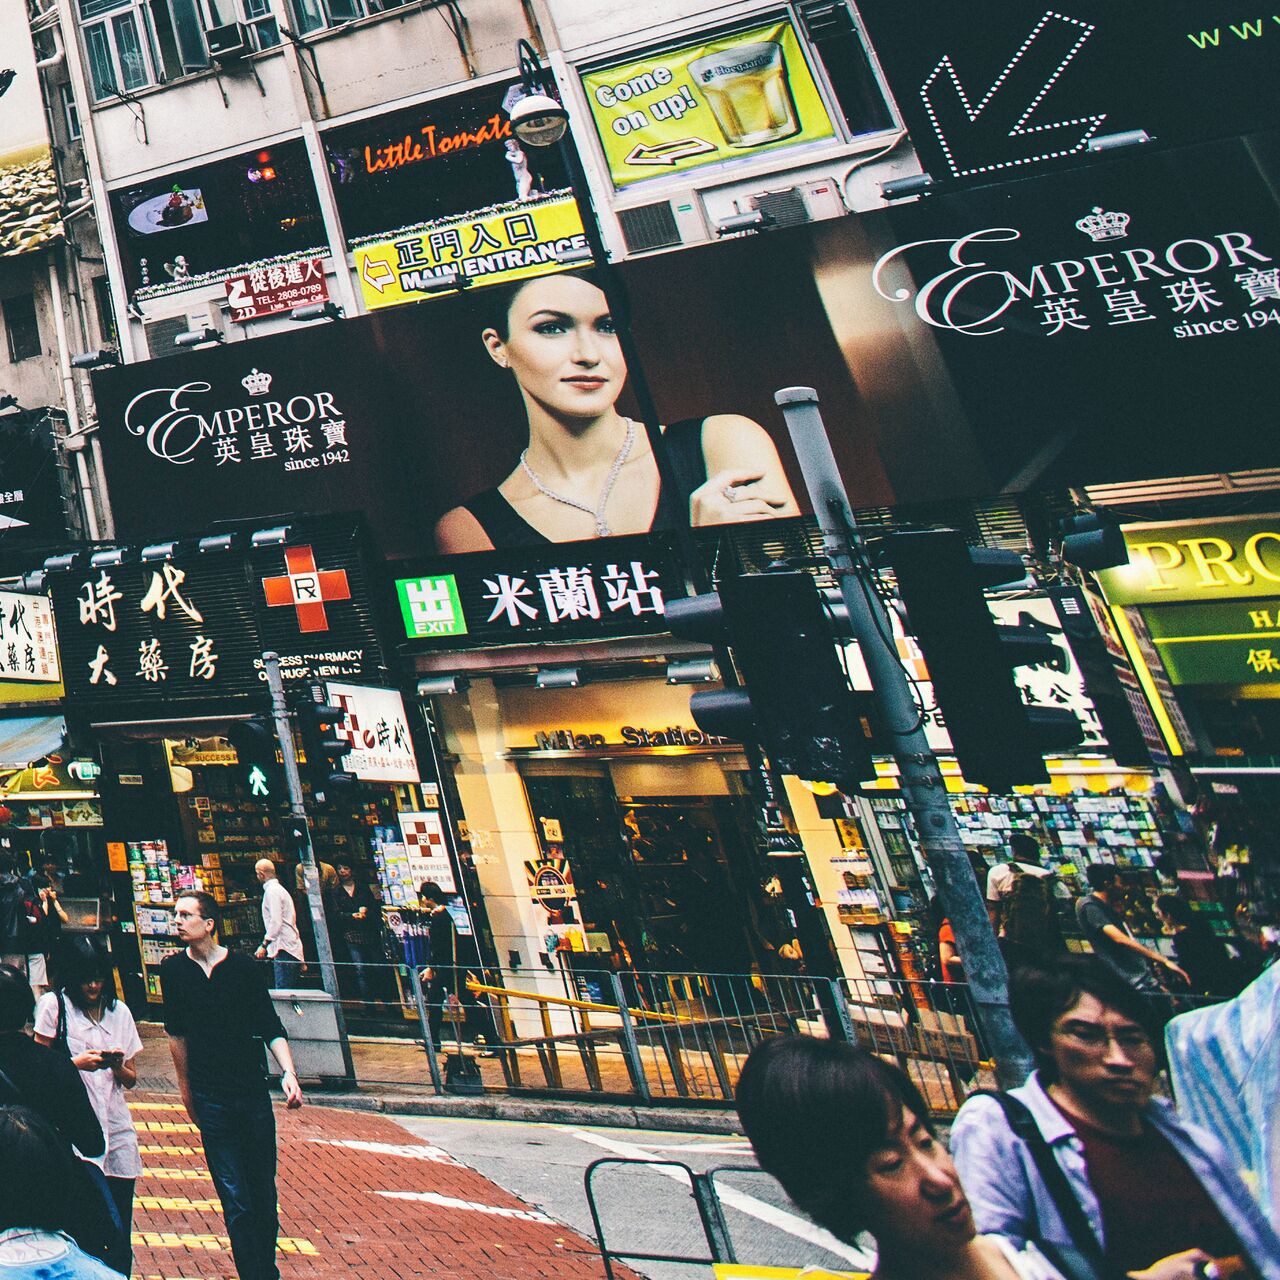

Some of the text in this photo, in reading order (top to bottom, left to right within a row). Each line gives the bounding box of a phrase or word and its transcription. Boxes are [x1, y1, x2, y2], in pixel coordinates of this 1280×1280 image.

[594, 65, 674, 108] Come
[611, 86, 699, 136] on up!
[364, 113, 513, 174] Little Tomat
[394, 212, 538, 270] 正門入口
[277, 283, 322, 301] 2808-0789
[399, 261, 461, 292] MAIN
[872, 227, 1273, 336] EMPEROR
[236, 306, 258, 319] 2D
[1173, 305, 1280, 340] since 194
[124, 380, 344, 465] EMPEROR
[212, 418, 350, 467] 英皇珠寶
[284, 448, 351, 472] since 1942
[76, 560, 205, 634] 時代
[405, 579, 455, 622] 出
[482, 560, 666, 627] 米蘭站
[415, 620, 456, 635] EXIT
[87, 634, 220, 687] 大藥房
[253, 654, 303, 670] SUCESS
[281, 668, 312, 681] HUGE
[535, 725, 730, 751] Milan Station
